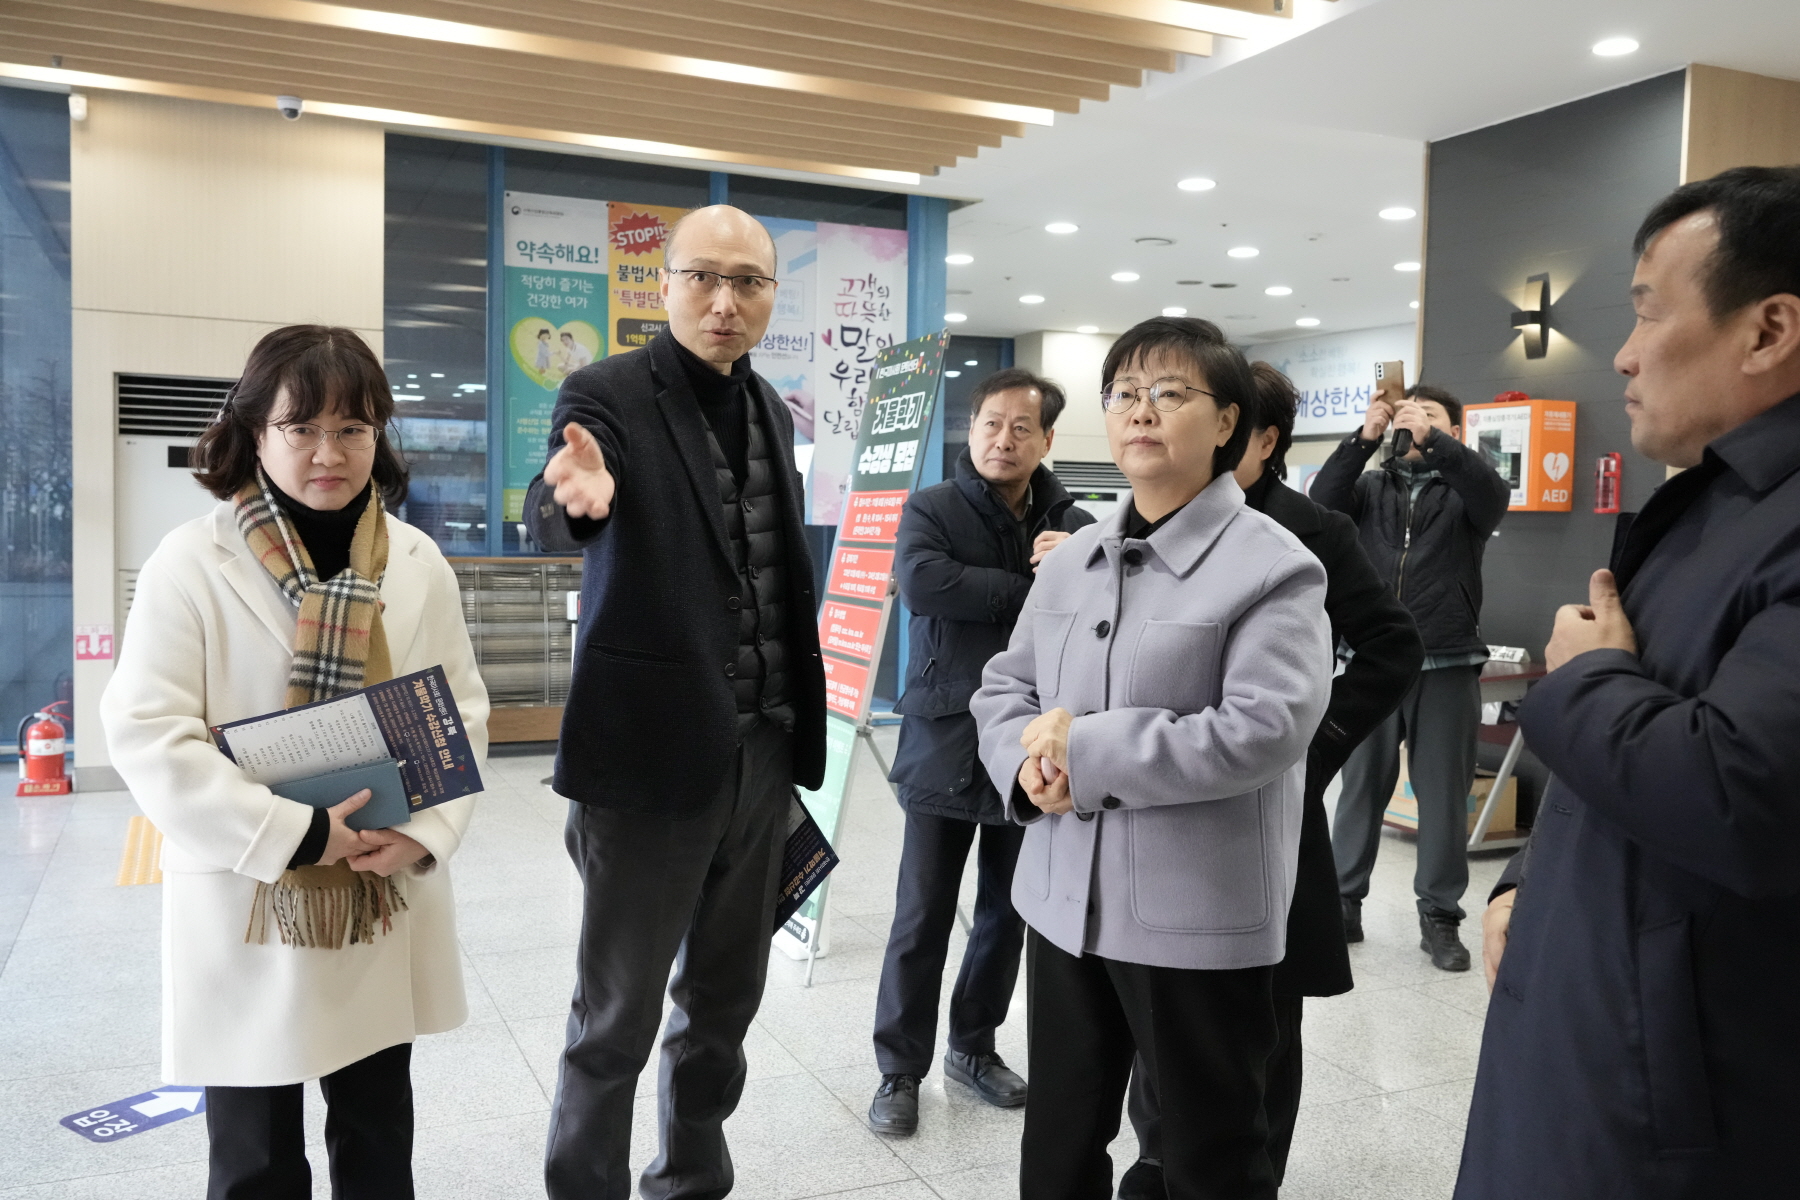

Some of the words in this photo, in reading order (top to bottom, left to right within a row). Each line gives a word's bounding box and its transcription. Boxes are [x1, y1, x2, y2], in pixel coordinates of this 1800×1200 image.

[617, 226, 664, 246] STOP!!
[516, 239, 599, 265] 약속해요!
[521, 275, 556, 290] 적당히
[559, 277, 594, 293] 즐기는
[617, 264, 659, 283] 불법사
[837, 273, 890, 299] 고객의
[526, 293, 562, 308] 건강한
[564, 296, 588, 310] 여가
[834, 302, 892, 323] 따뜻한
[641, 322, 661, 333] 신고시
[755, 333, 808, 351] 상한선!
[830, 360, 873, 390] 우리
[872, 391, 925, 434] 겨울학기
[824, 410, 860, 441] 달립
[857, 443, 894, 475] 수강생
[892, 439, 919, 472] 모집
[1542, 489, 1568, 503] AED
[425, 713, 447, 748] 수강신청
[438, 749, 454, 770] 안내
[73, 1110, 138, 1137] 입장
